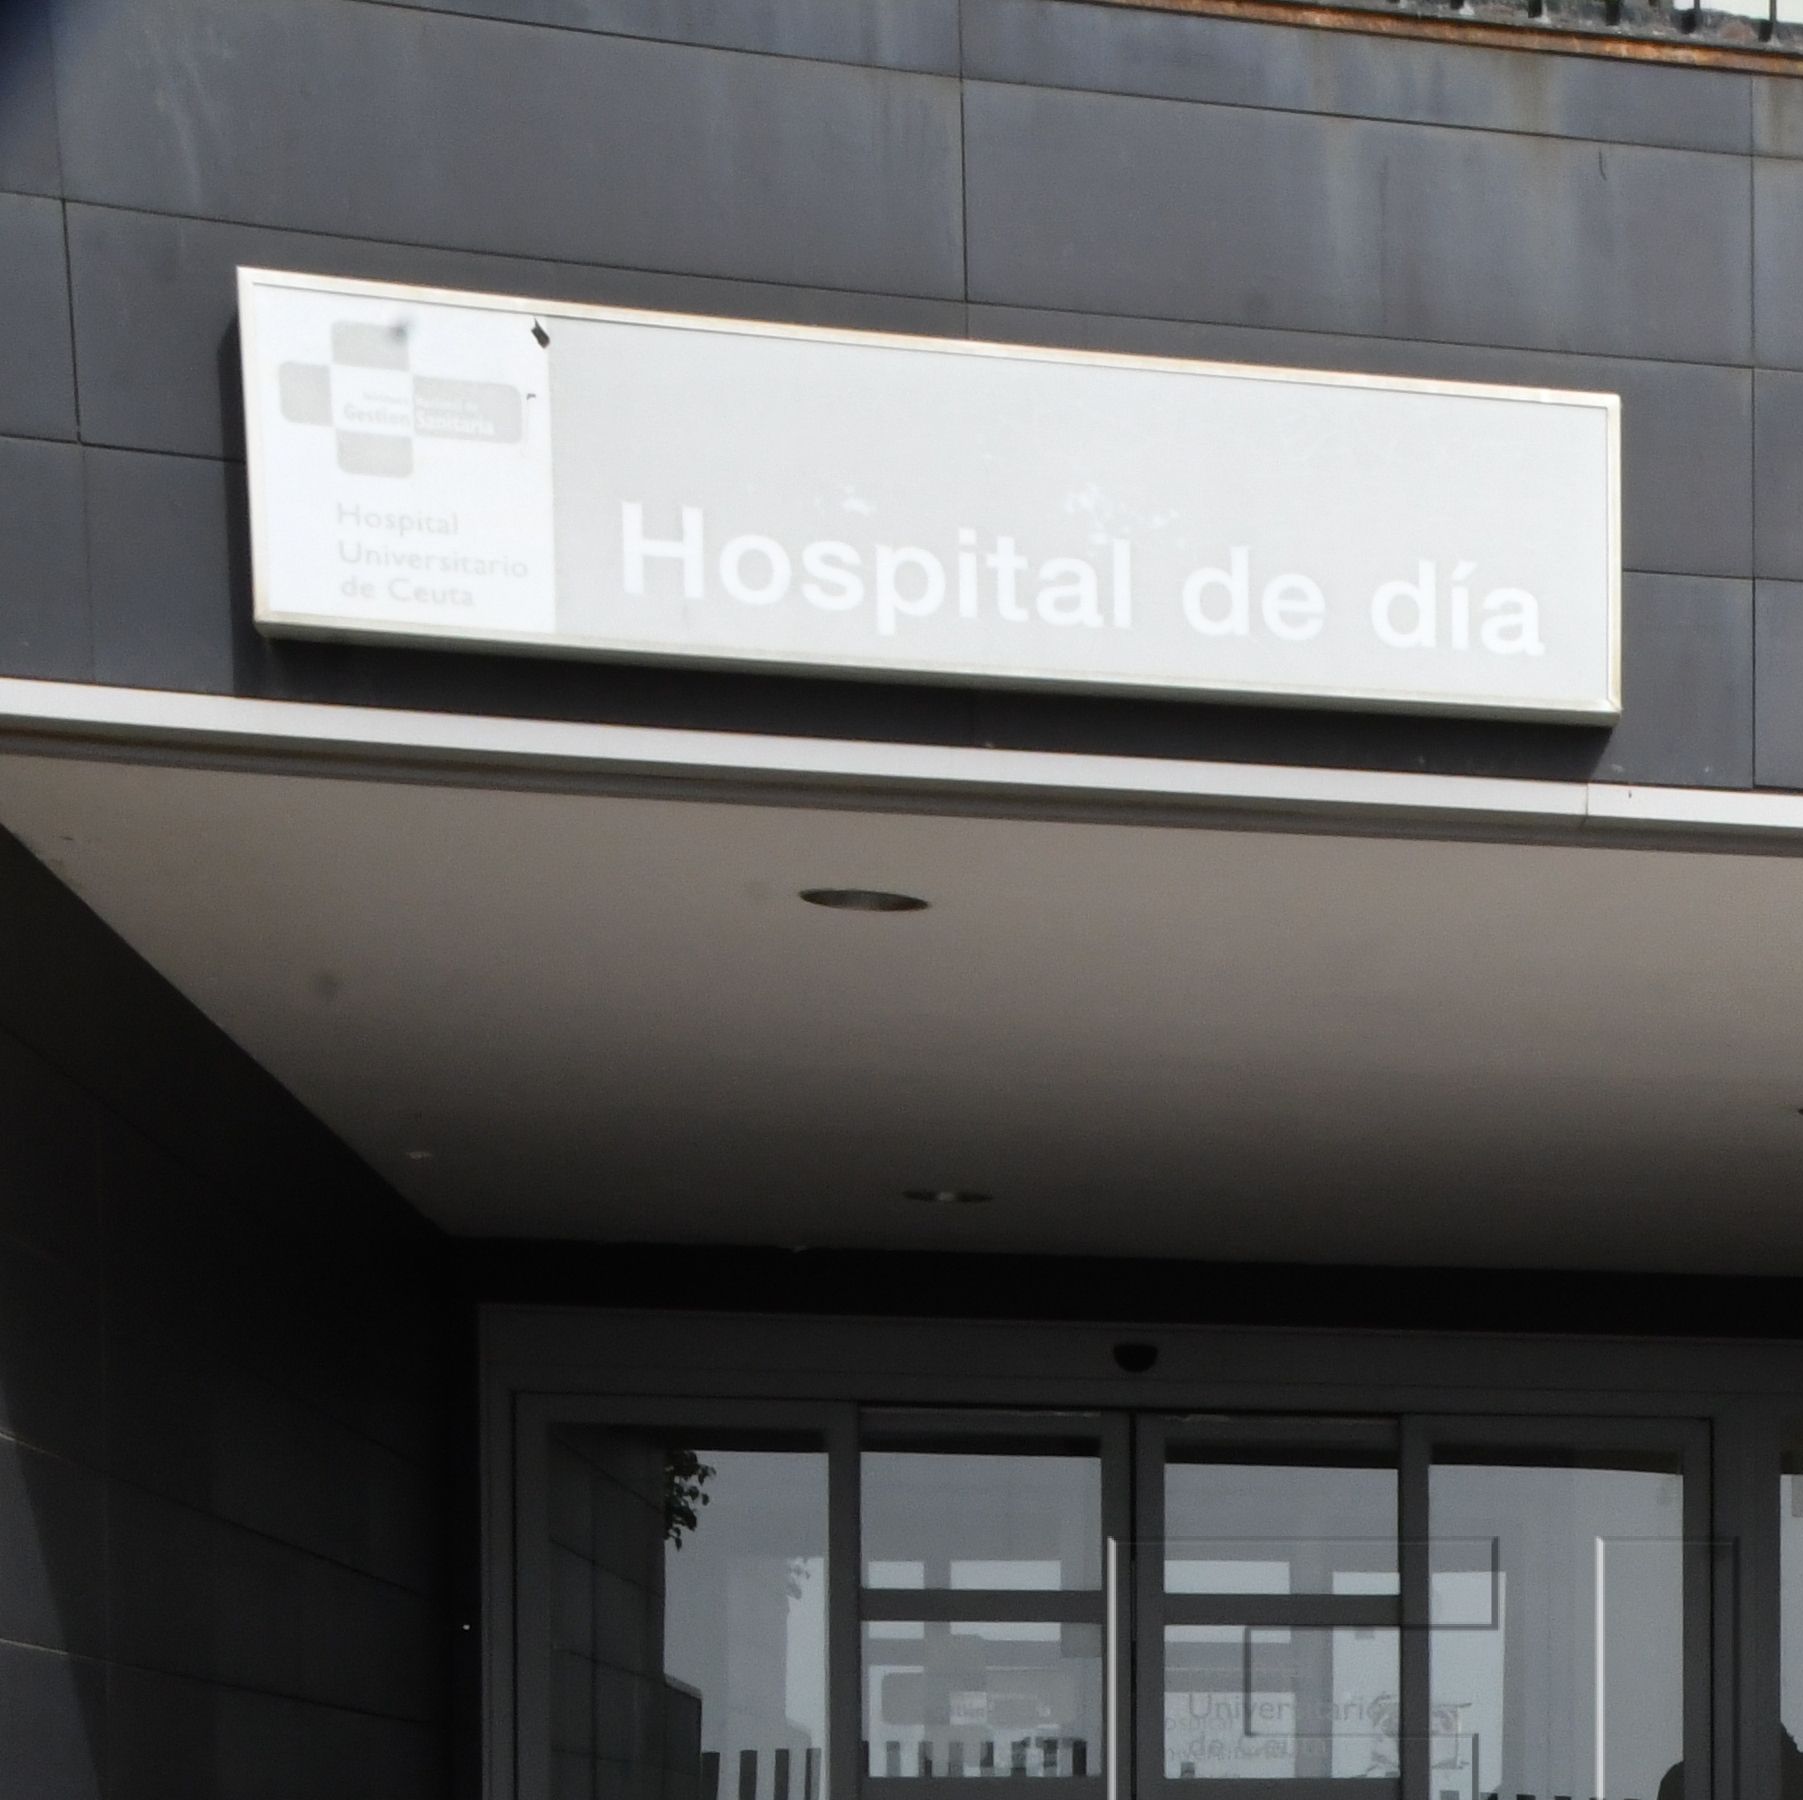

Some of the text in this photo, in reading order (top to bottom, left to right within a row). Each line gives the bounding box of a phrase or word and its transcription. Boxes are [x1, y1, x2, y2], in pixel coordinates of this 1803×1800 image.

[337, 501, 459, 536] Hospital
[338, 538, 529, 579] Universitario
[621, 499, 1545, 656] Hospital de día
[340, 575, 475, 608] de Ceuta
